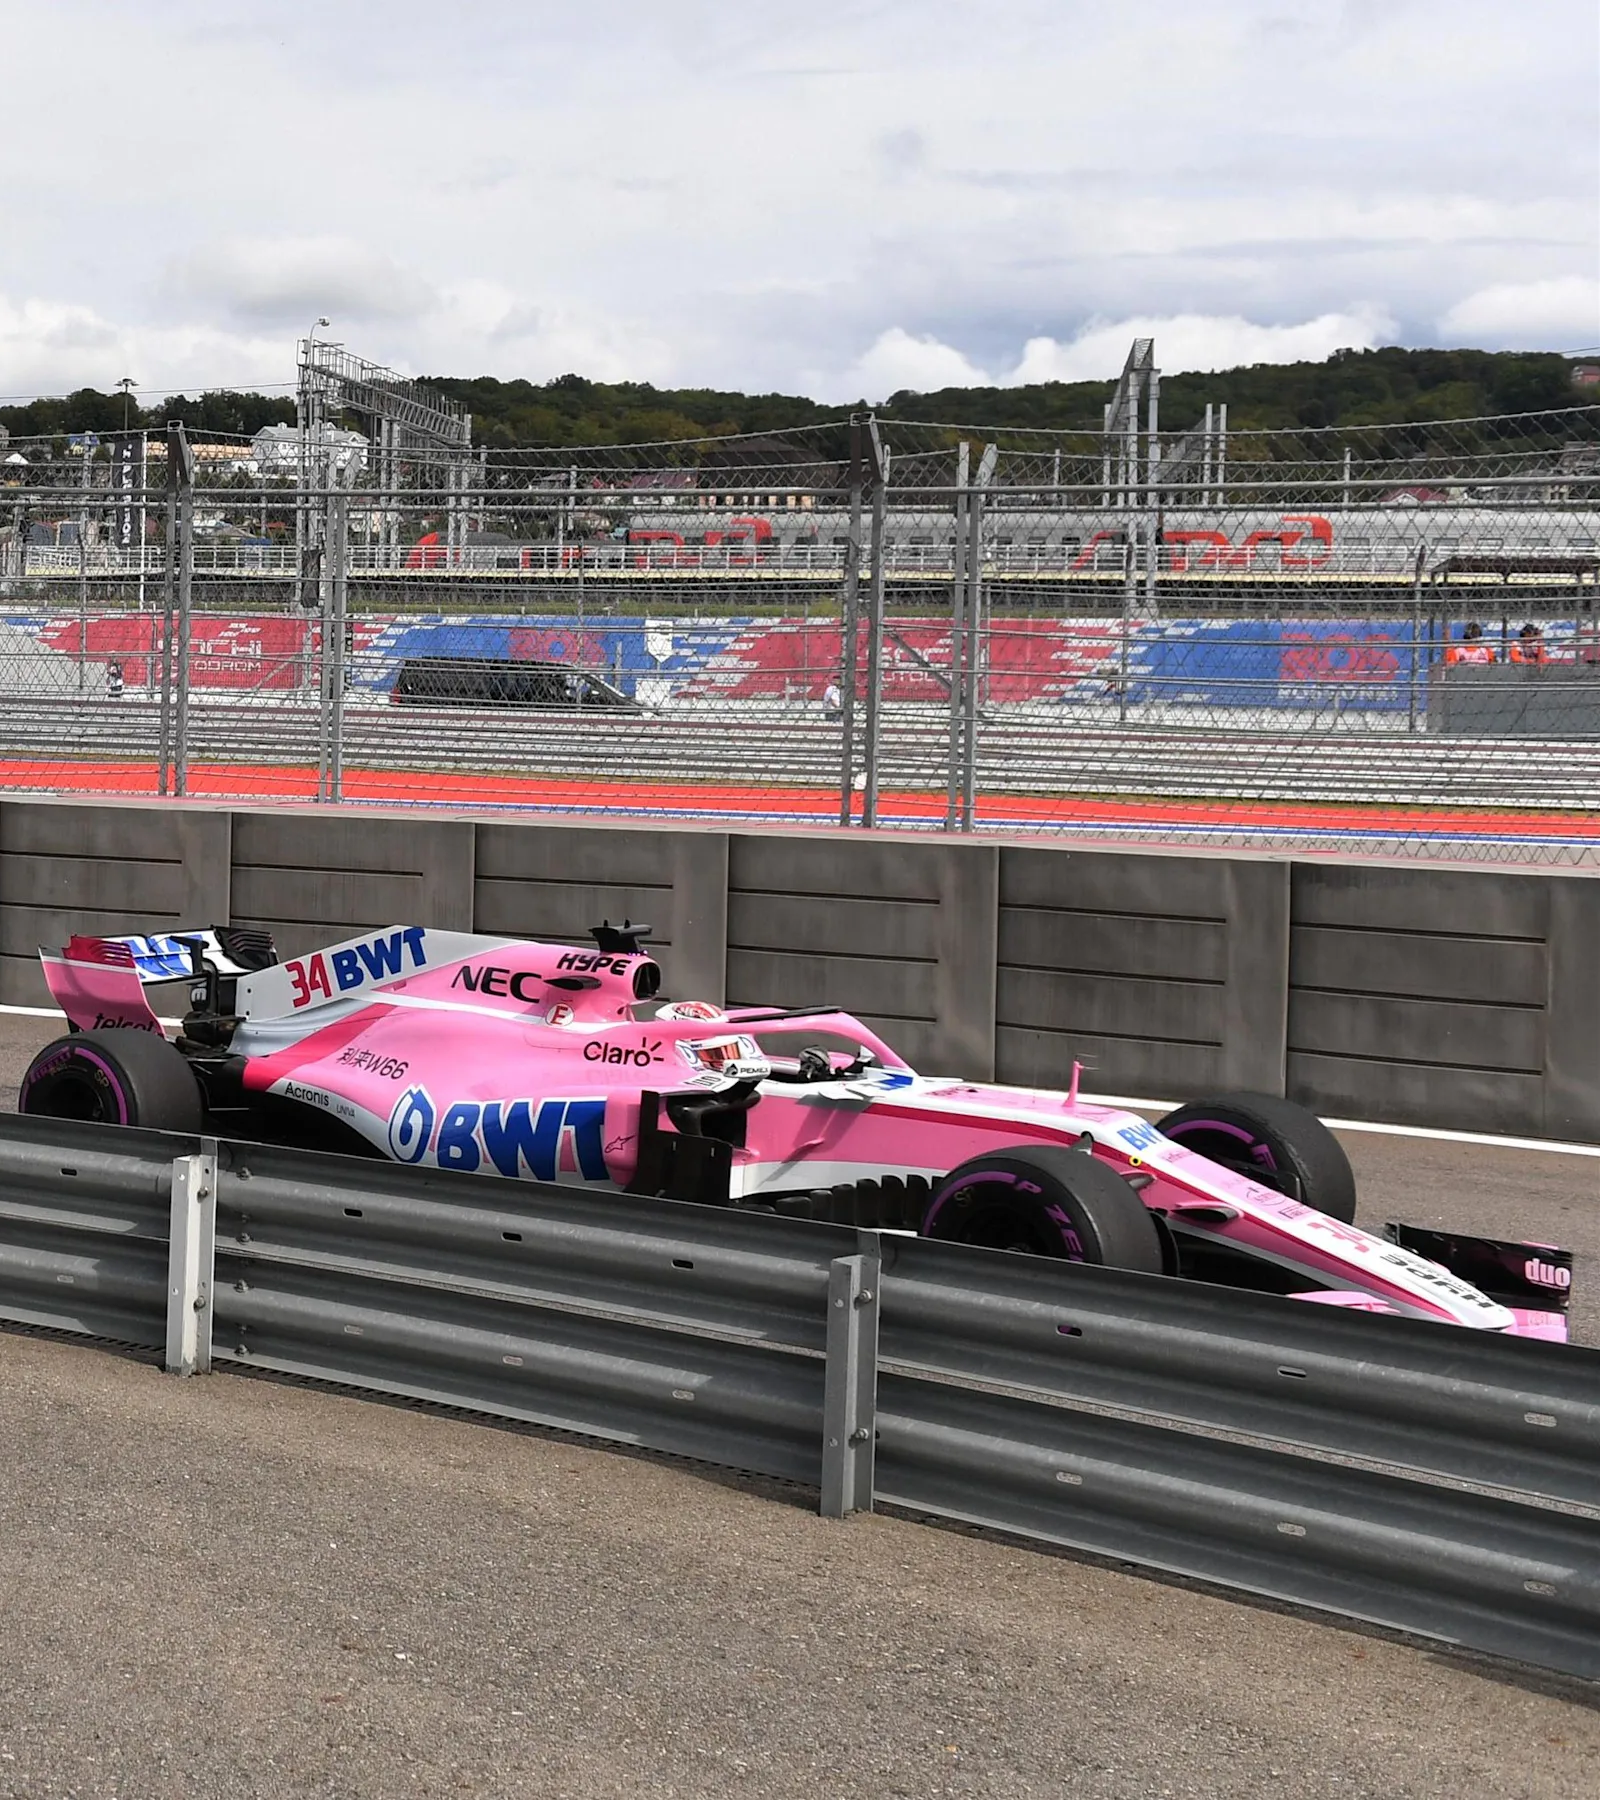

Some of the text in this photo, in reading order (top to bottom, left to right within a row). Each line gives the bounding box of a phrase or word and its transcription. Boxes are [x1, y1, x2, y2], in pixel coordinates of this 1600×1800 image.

[331, 926, 427, 991] BWT
[556, 952, 633, 976] HYPE
[285, 953, 332, 1008] 34
[451, 965, 542, 1004] NEC
[551, 1006, 568, 1025] E
[583, 1040, 652, 1067] Claro
[285, 1082, 329, 1107] Acronis
[437, 1100, 611, 1181] BWT
[1116, 1123, 1163, 1151] BW
[1524, 1258, 1572, 1288] duo
